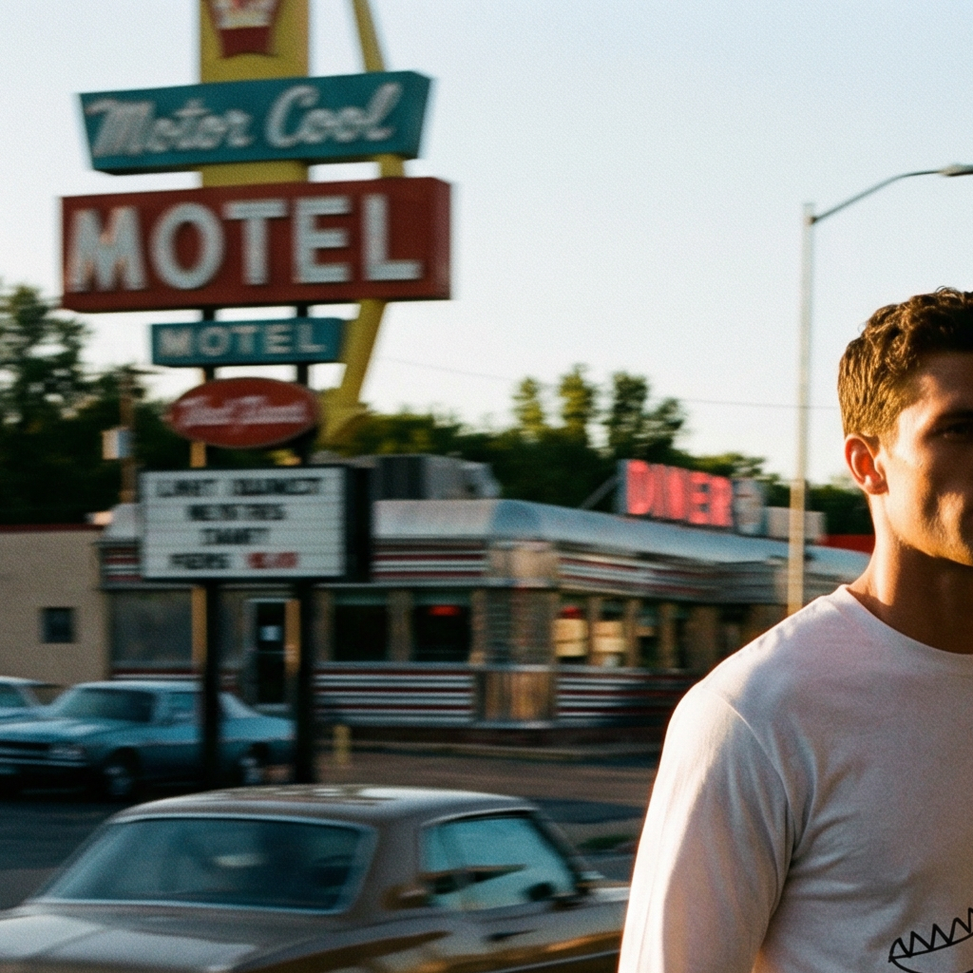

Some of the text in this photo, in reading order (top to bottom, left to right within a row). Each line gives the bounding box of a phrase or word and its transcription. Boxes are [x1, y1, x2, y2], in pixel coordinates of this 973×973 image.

[263, 82, 403, 148] Cool
[65, 194, 424, 292] MOTEL
[157, 323, 326, 358] MOTEL
